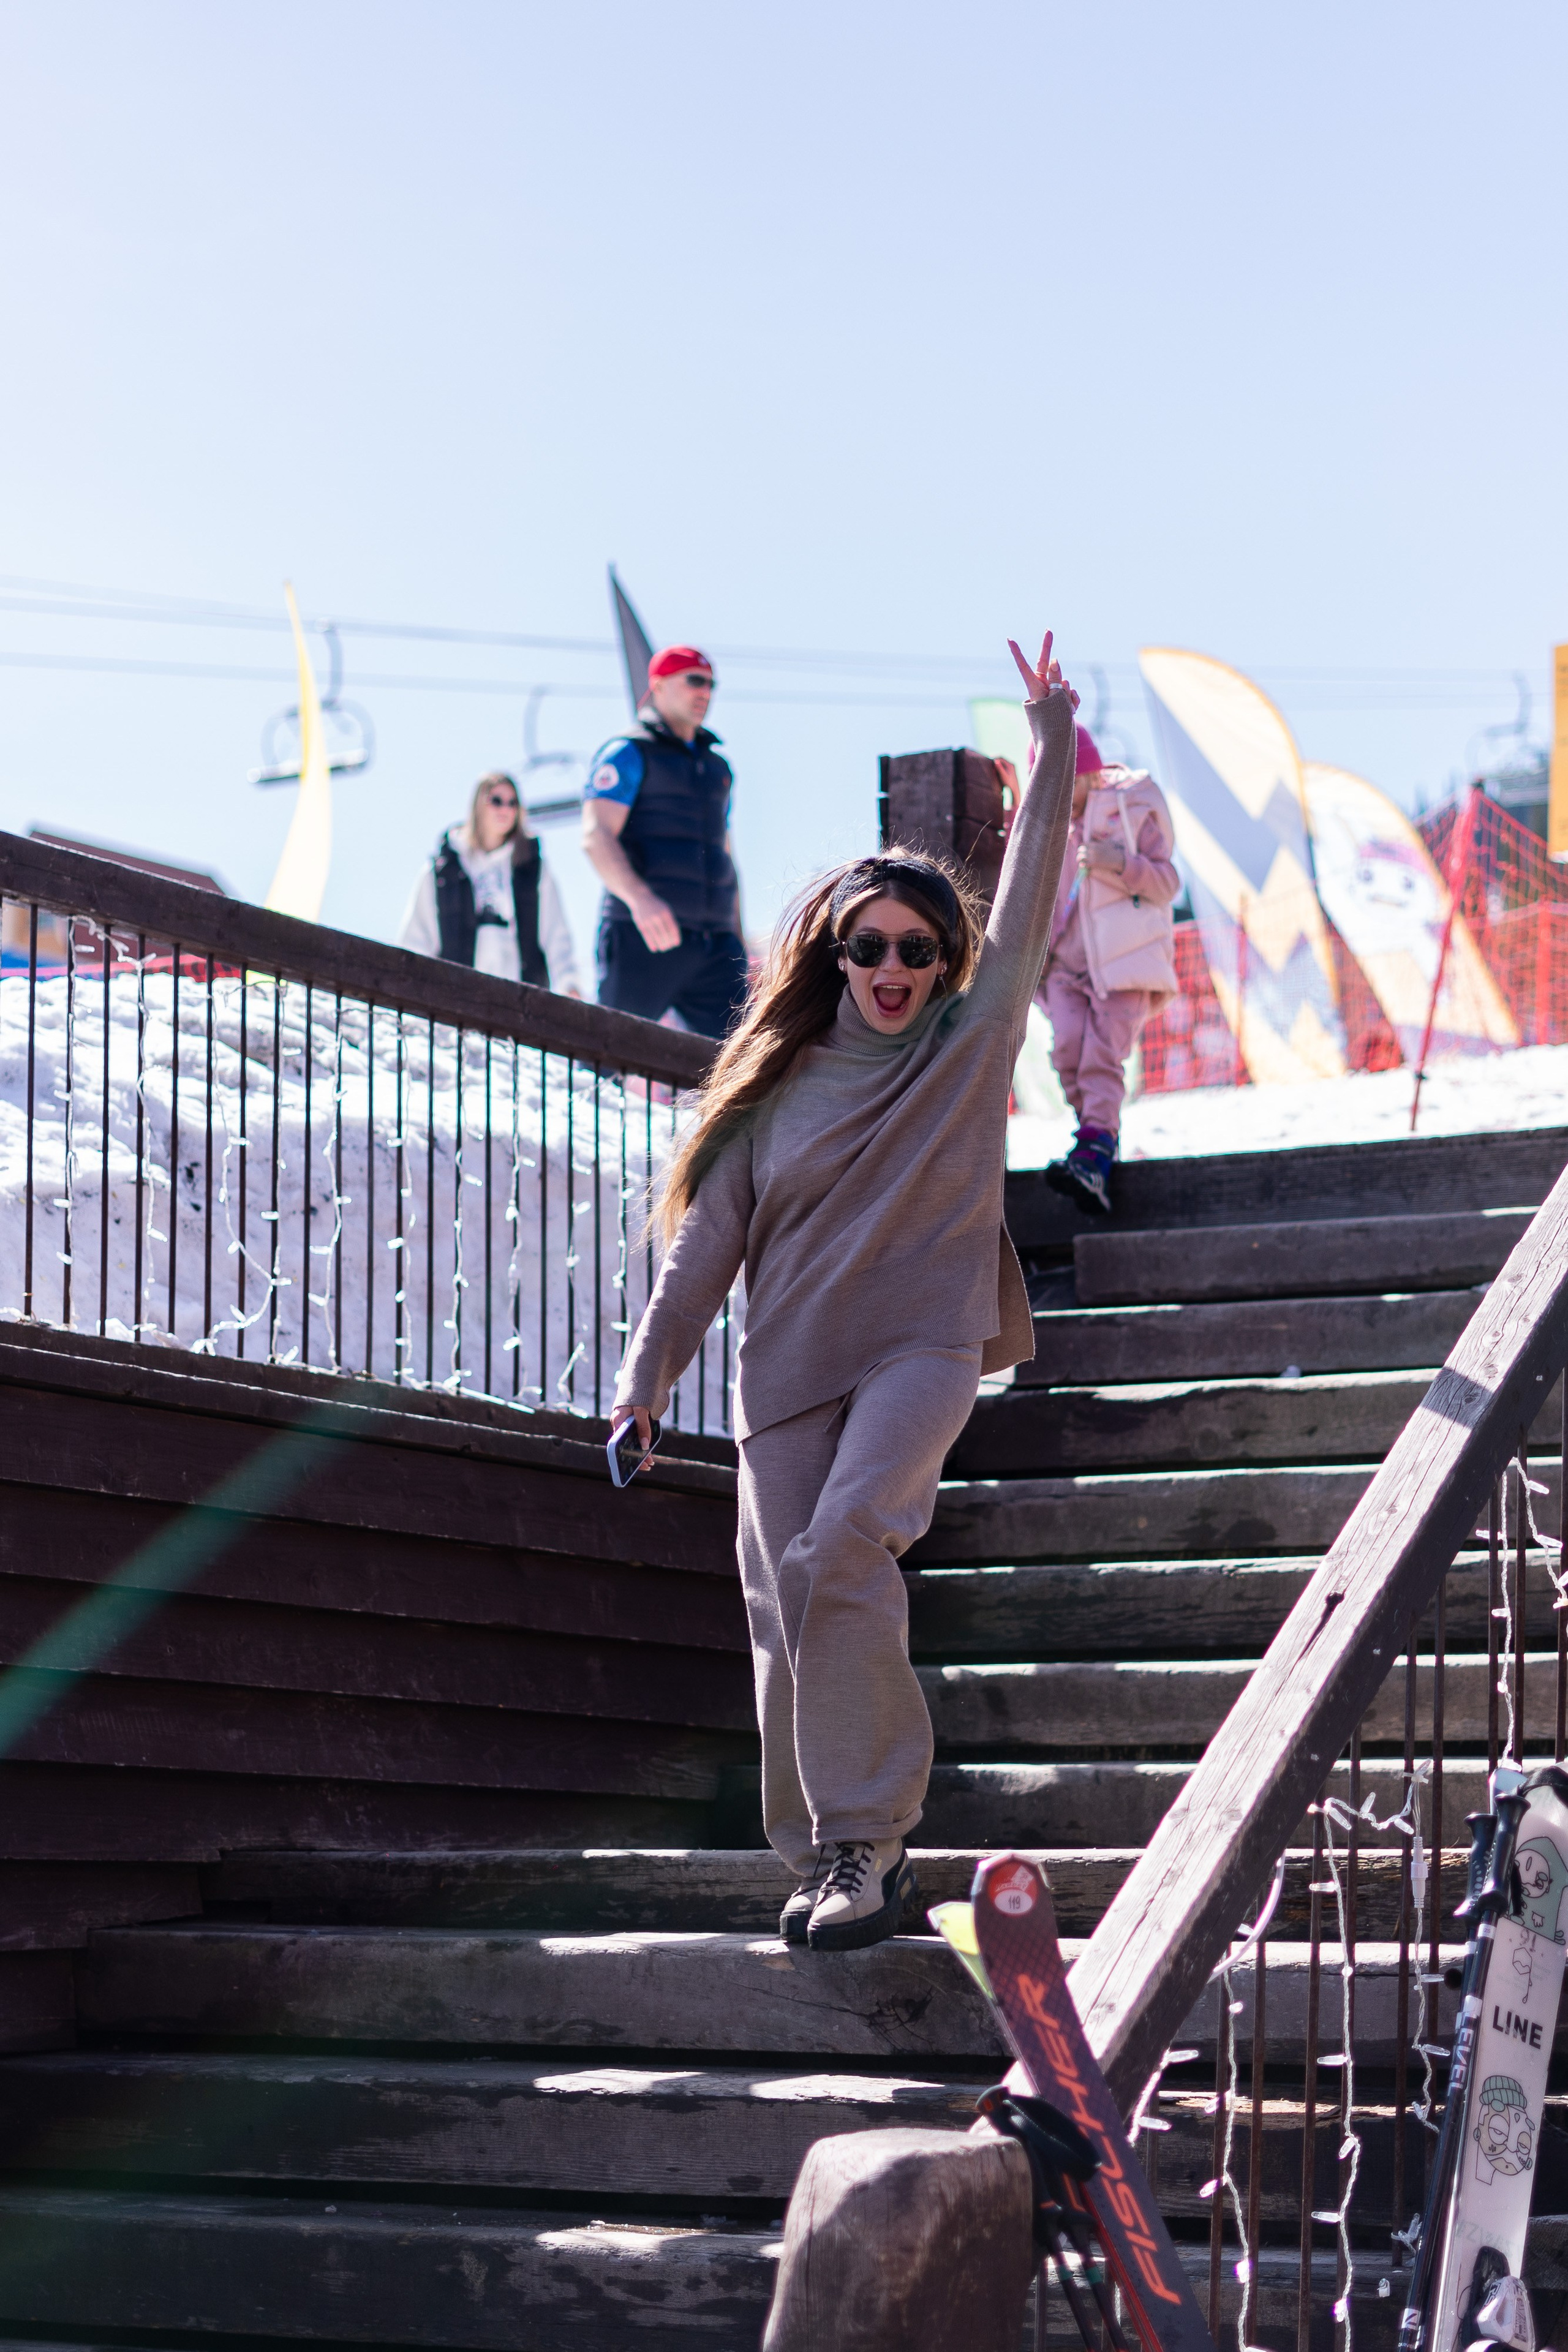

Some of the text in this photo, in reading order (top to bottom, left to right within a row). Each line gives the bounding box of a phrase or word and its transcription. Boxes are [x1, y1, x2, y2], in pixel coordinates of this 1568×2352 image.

[1008, 1896, 1021, 1909] 119
[1447, 2011, 1478, 2097] LEVEL
[1493, 2005, 1543, 2049] LINE
[1017, 1972, 1182, 2305] FISCHER
